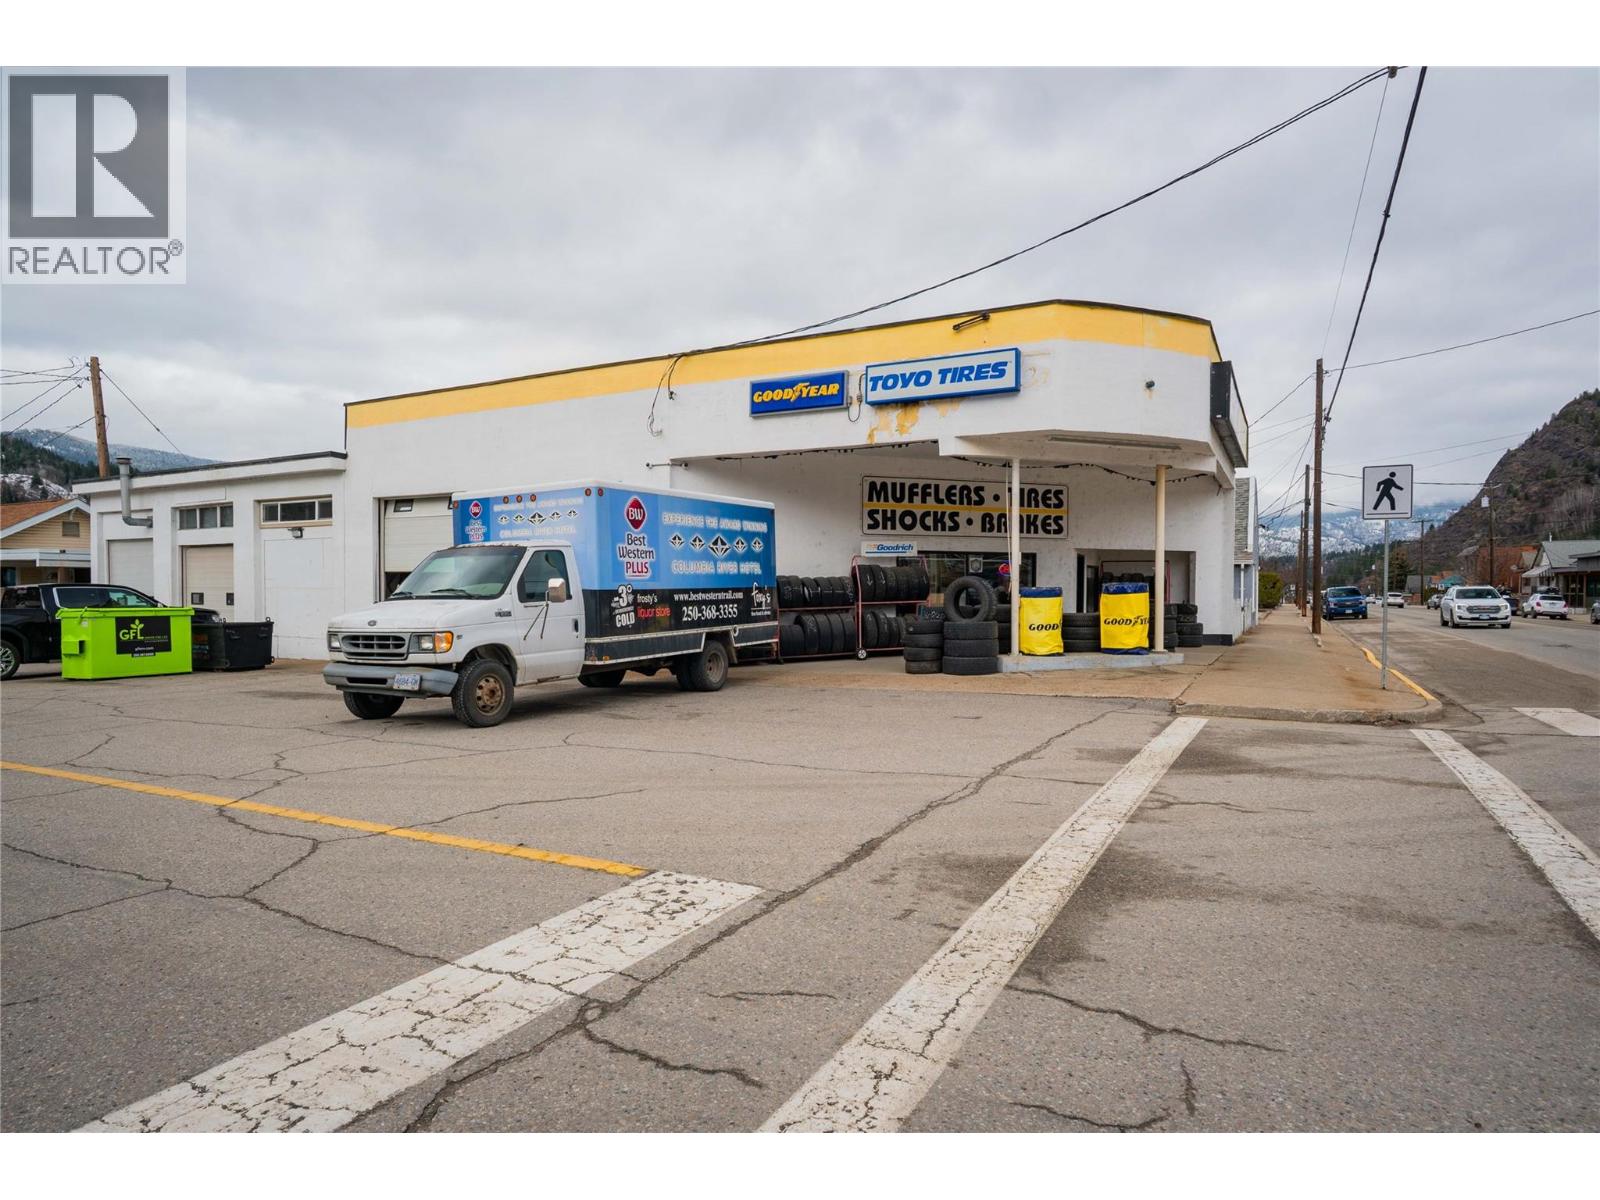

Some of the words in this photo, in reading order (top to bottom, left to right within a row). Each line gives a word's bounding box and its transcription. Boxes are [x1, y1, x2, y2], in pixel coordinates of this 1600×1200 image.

[869, 369, 932, 392] TOYO
[938, 360, 1009, 384] TIRES
[753, 382, 840, 403] GOODYEAR
[867, 480, 985, 506] MUFFLERS
[628, 507, 643, 520] BW
[867, 508, 960, 532] SHOCKS
[626, 533, 646, 546] Best
[618, 546, 655, 560] Western
[868, 543, 914, 552] Goodrich
[625, 561, 649, 574] PLUS
[671, 560, 715, 574] COLUMBIA
[716, 561, 738, 574] RIVER
[739, 562, 762, 575] HOTEL
[636, 593, 658, 605] frosty's
[655, 607, 671, 617] store
[682, 605, 738, 622] 250-368-3355
[615, 612, 636, 628] COLD
[119, 626, 145, 640] GFL
